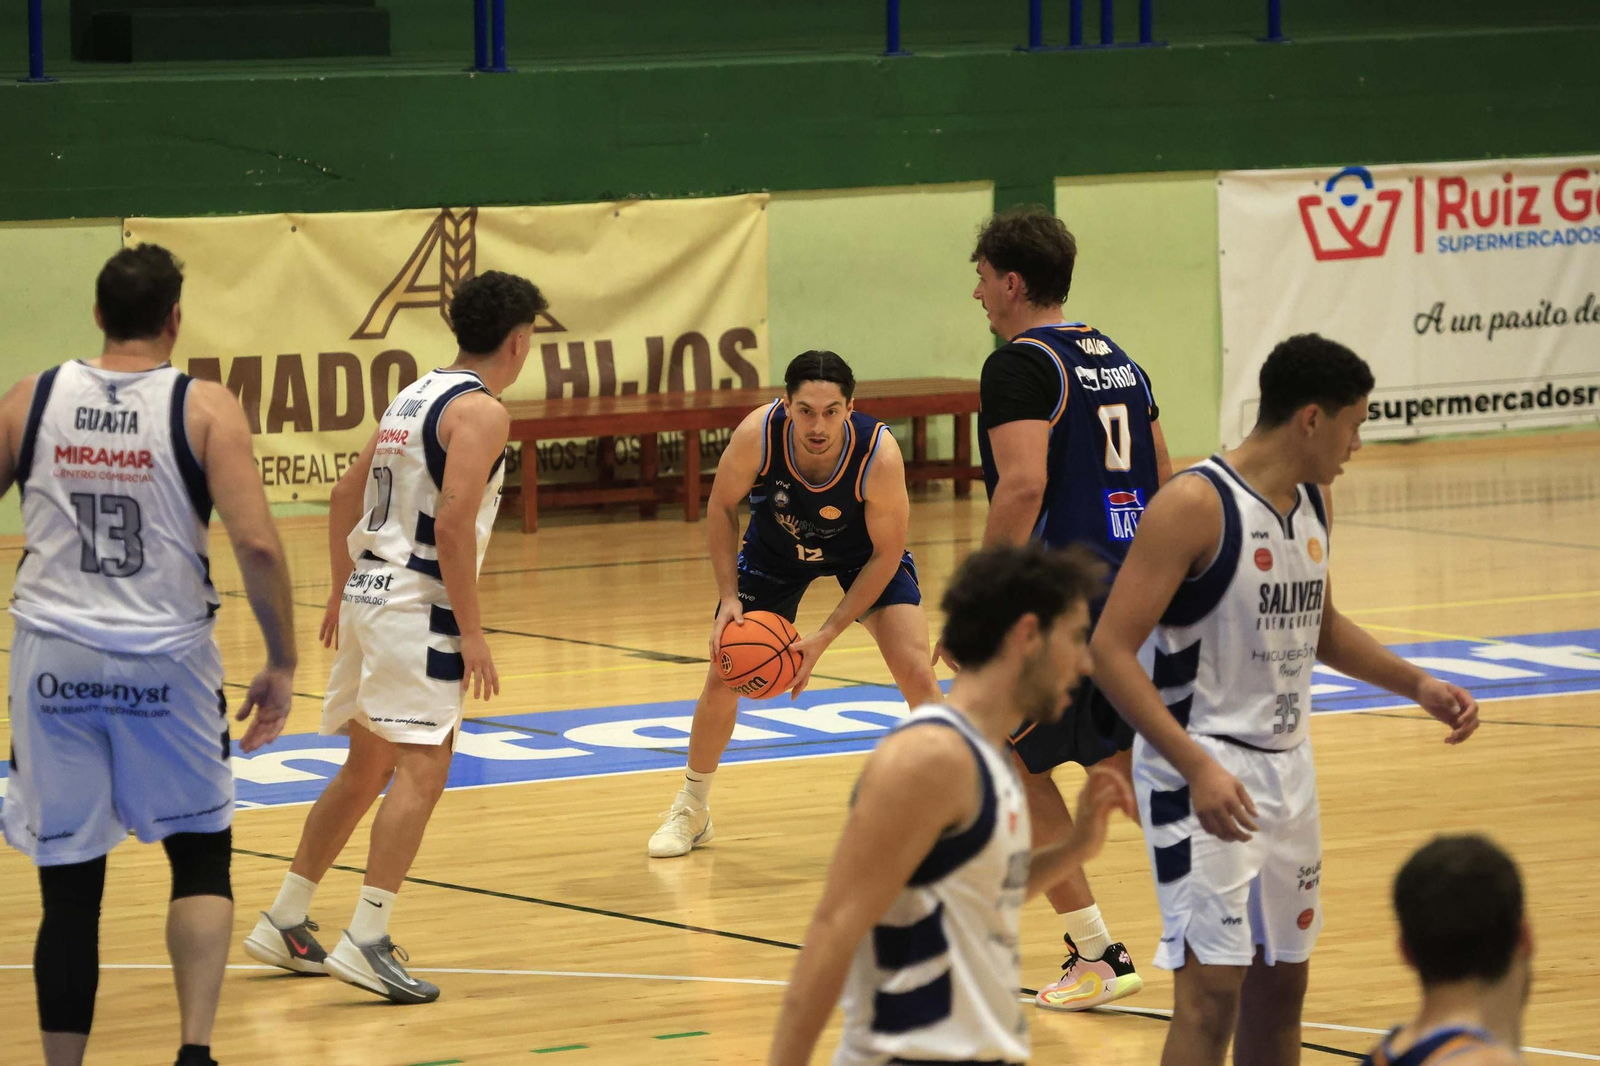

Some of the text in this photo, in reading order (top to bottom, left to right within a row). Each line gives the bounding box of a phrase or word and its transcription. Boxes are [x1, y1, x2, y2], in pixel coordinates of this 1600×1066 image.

[1437, 167, 1600, 231] Ruiz G
[1437, 226, 1600, 254] SUPERMERCADOS
[1413, 301, 1446, 335] A
[1451, 313, 1482, 332] un
[1487, 299, 1567, 341] pasito
[169, 349, 418, 435] MADO
[54, 445, 154, 469] MIRAMAR
[1097, 403, 1132, 472] 0
[53, 468, 156, 483] CENTRO COMERCIAL
[253, 451, 360, 486] EREALE
[70, 491, 144, 578] 13
[795, 544, 825, 563] 12
[1259, 579, 1324, 615] SALIVER
[1272, 692, 1302, 735] 35
